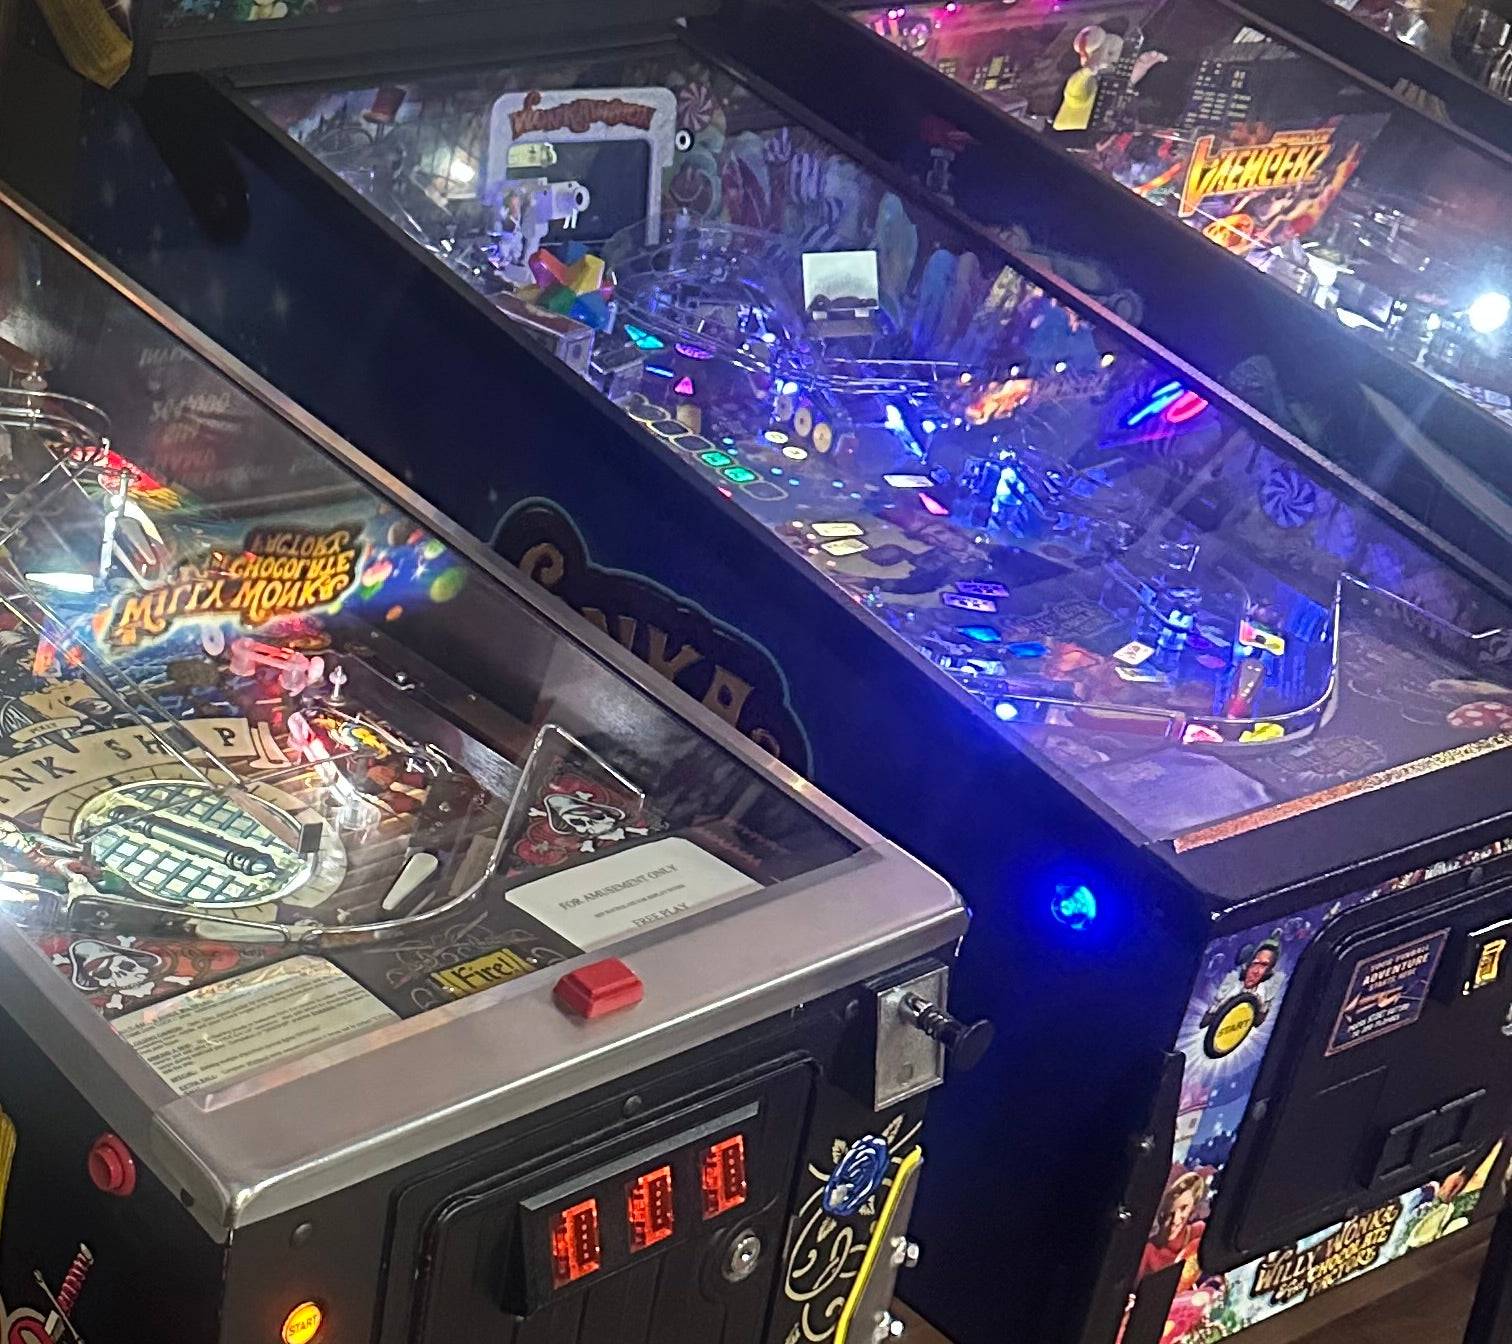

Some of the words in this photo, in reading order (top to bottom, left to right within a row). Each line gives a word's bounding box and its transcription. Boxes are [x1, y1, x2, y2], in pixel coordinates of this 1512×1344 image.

[103, 727, 236, 761] SHP
[558, 897, 583, 911] FOR
[584, 874, 648, 903] AMUSEMENT
[648, 863, 678, 880] ONLY
[632, 912, 662, 928] FREE
[663, 903, 691, 920] PLAY
[1362, 952, 1430, 986] ADVENTURE
[289, 1314, 317, 1336] START
